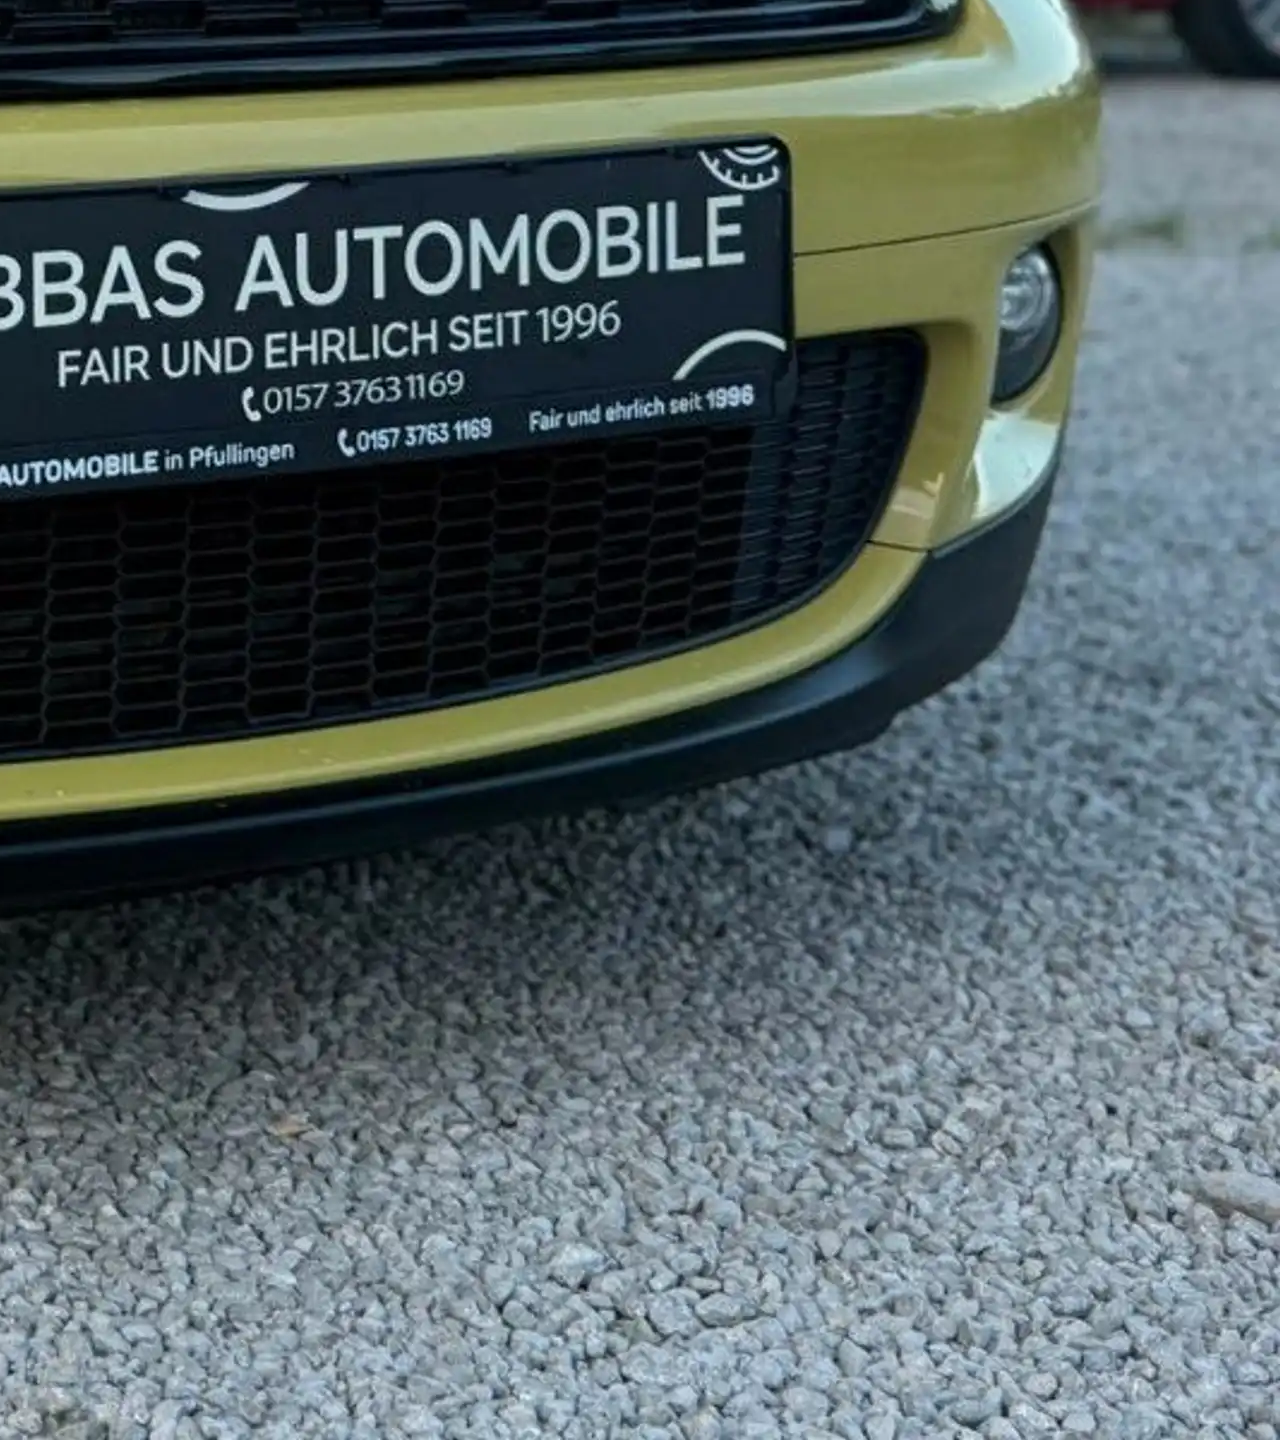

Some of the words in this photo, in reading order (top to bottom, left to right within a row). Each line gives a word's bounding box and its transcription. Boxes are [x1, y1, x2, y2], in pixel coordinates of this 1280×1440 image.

[234, 195, 746, 312] AUTOMOBILE
[57, 345, 151, 388] FAIR
[162, 336, 254, 379] UND
[264, 319, 438, 370] EHRLICH
[448, 310, 529, 352] SEIT
[537, 300, 622, 343] 1996
[263, 383, 330, 414] 0157
[529, 409, 564, 433] Fair
[567, 403, 601, 428] und
[605, 395, 665, 422] ehrlich
[669, 392, 703, 414] seit
[355, 428, 401, 453] 0157
[404, 421, 450, 447] 3763
[453, 417, 493, 441] 1169
[164, 448, 184, 471] in
[189, 441, 296, 470] Pfullingen
